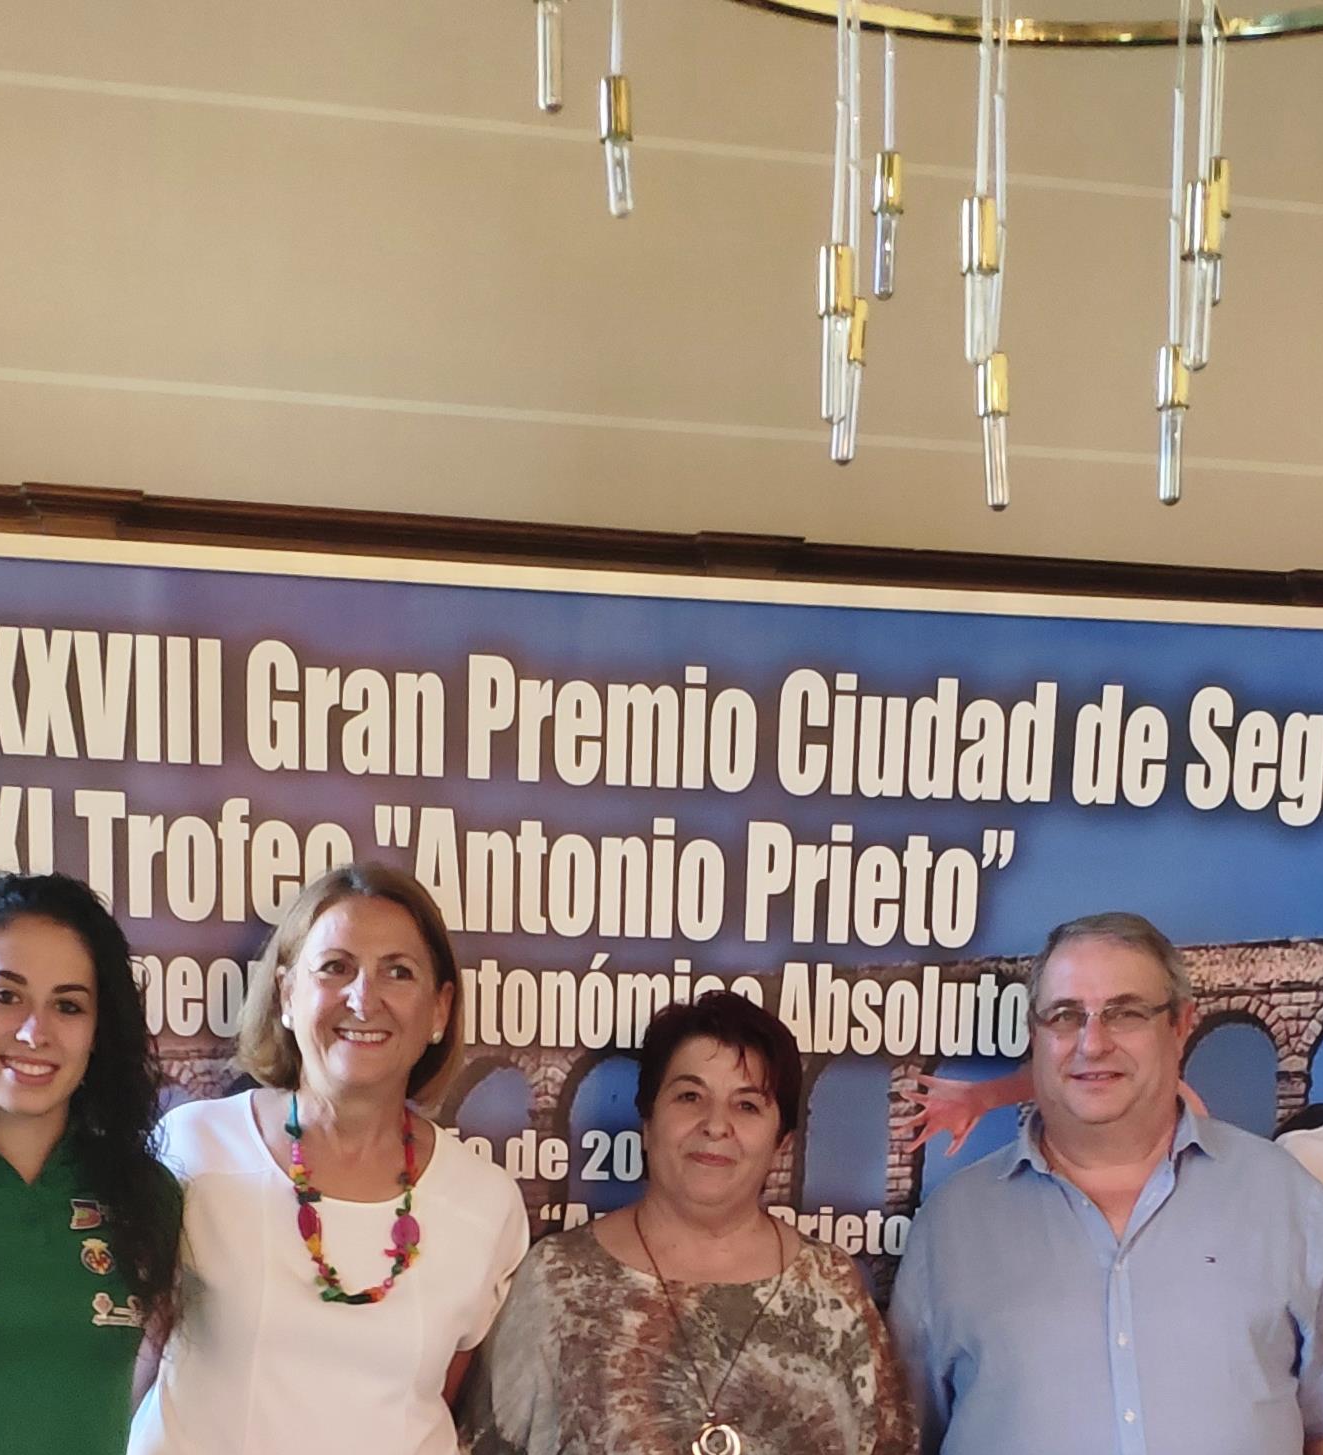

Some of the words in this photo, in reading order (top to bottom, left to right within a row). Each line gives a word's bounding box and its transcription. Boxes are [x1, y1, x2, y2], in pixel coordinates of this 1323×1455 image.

[246, 639, 445, 779] Gran
[466, 653, 757, 794] Premio
[778, 667, 1059, 803] Ciudad
[1075, 684, 1170, 808] de
[506, 1129, 569, 1181] de
